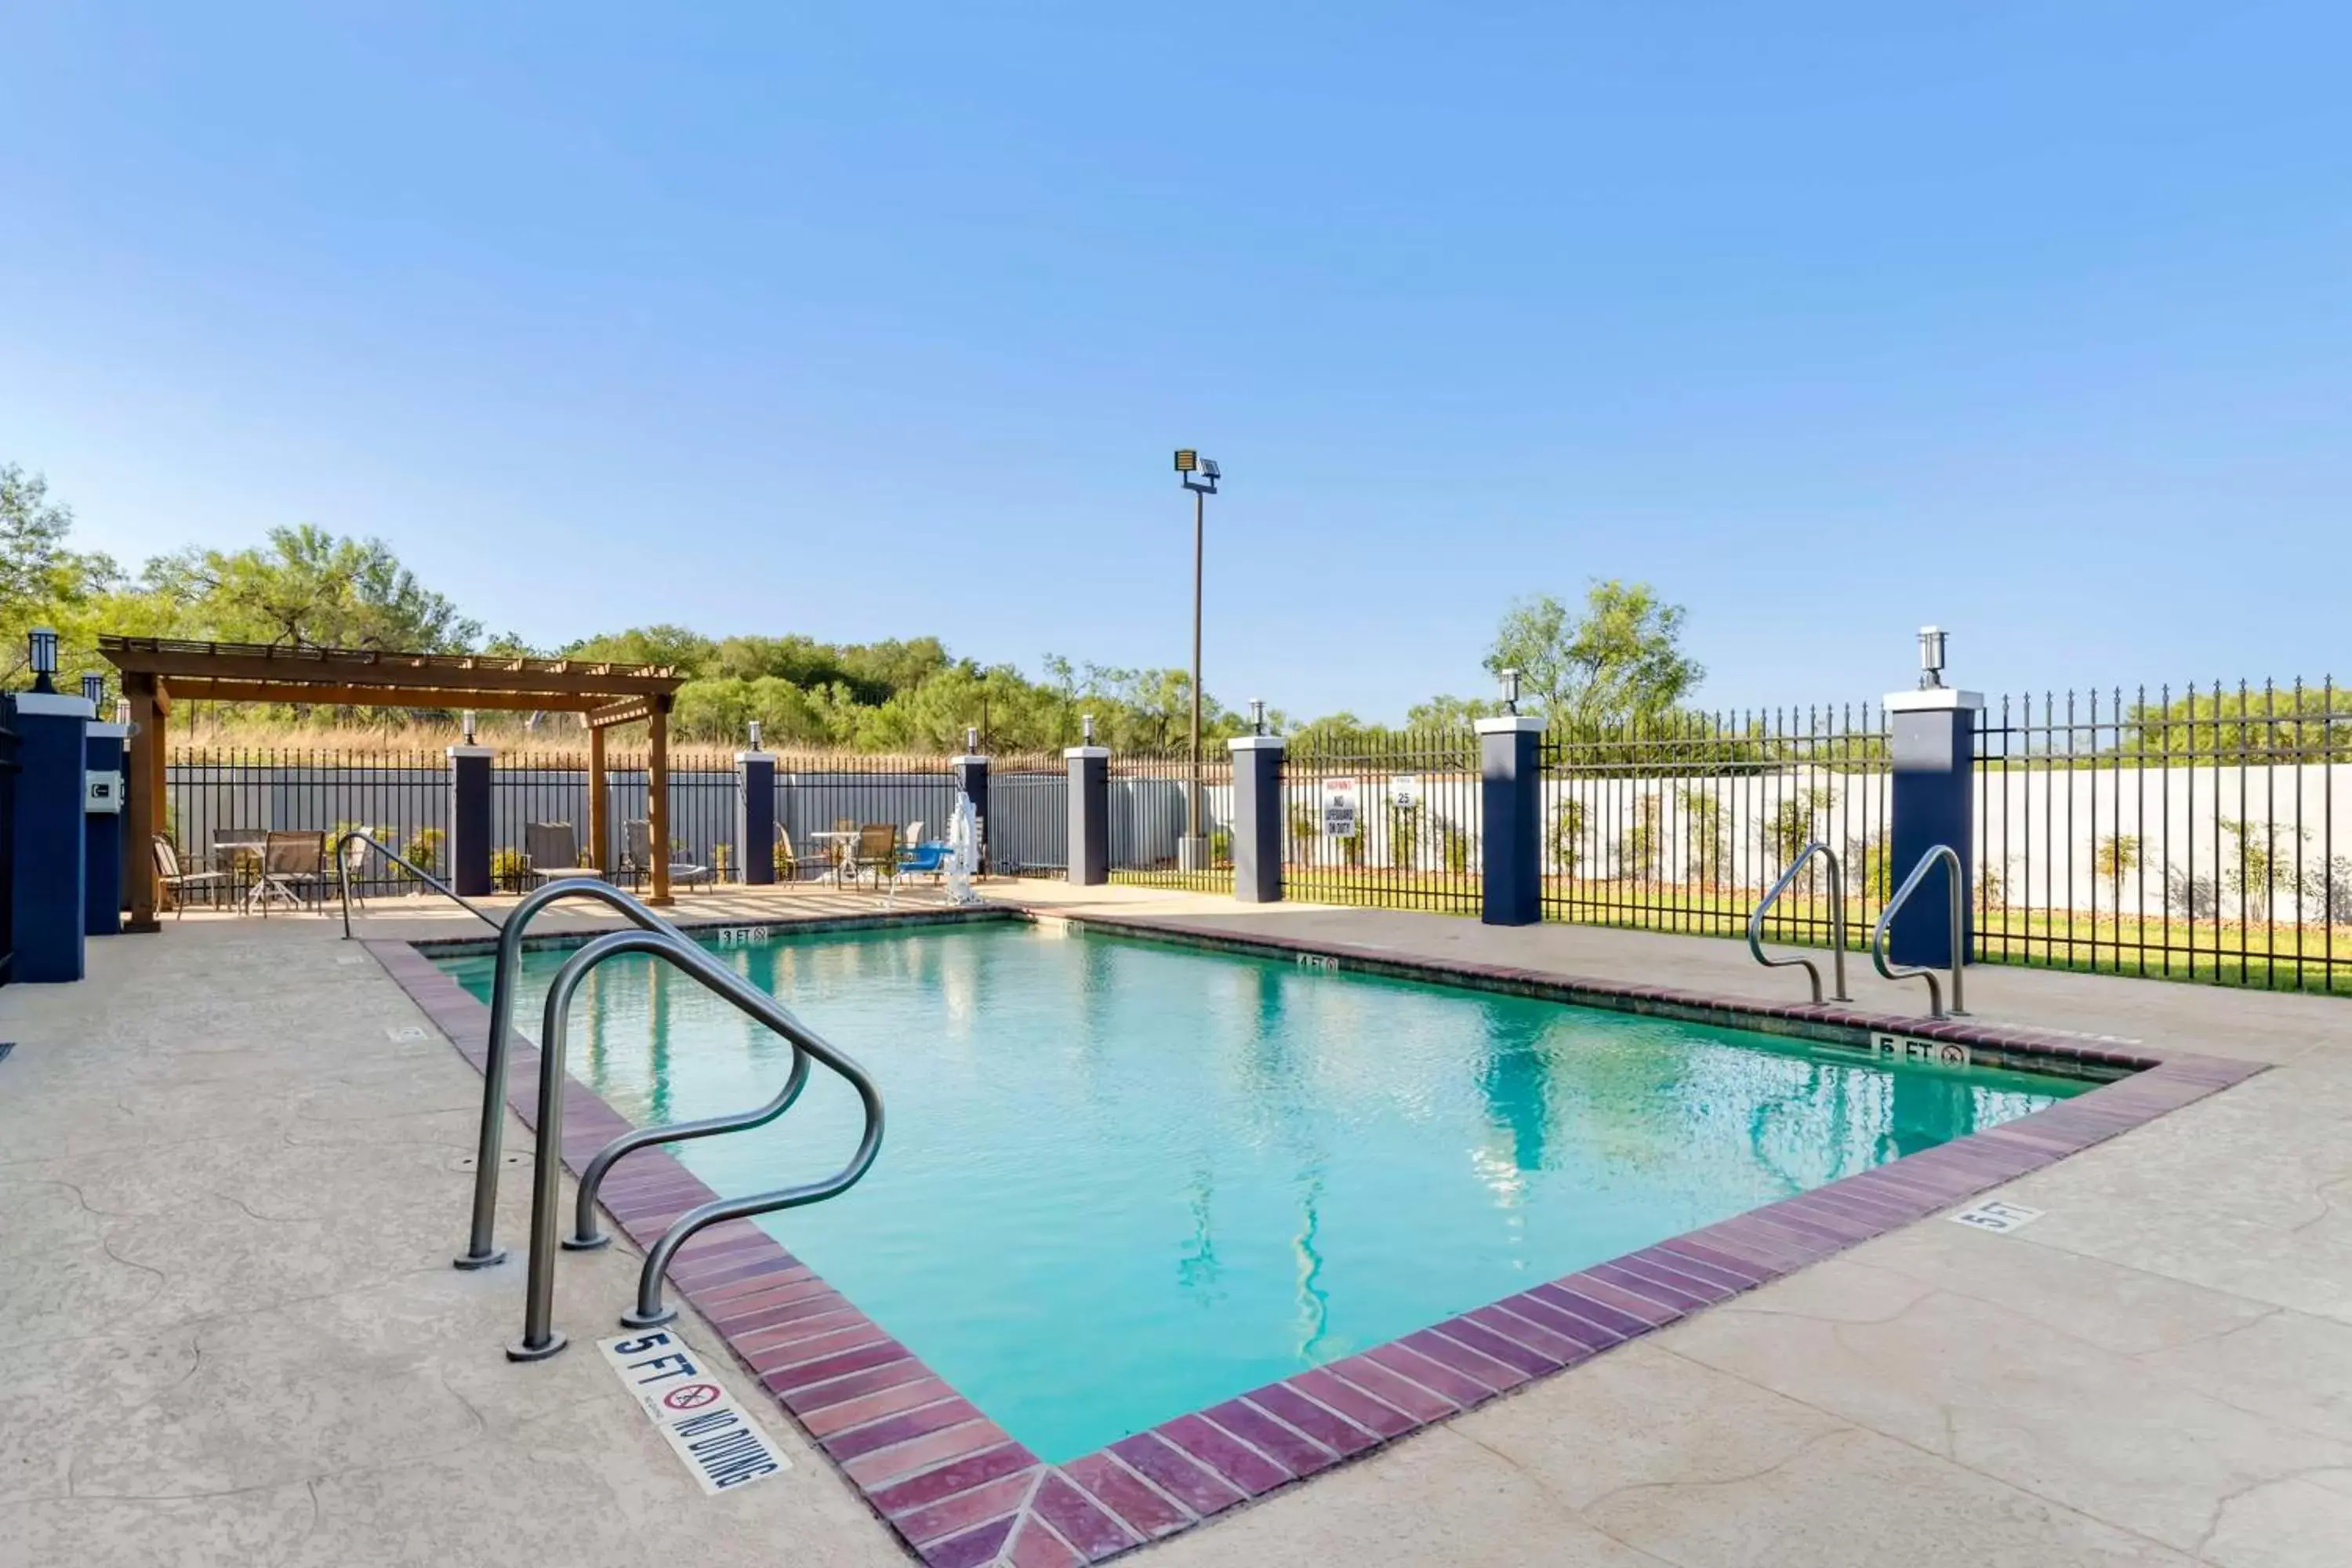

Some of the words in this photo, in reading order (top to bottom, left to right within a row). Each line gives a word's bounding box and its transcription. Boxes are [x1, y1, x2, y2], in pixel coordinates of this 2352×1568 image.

[1398, 793, 1410, 804] 25
[737, 929, 750, 942] FT
[1906, 1040, 1933, 1060] FT
[1961, 1214, 2008, 1229] 5
[1980, 1202, 2034, 1221] FT
[614, 1333, 670, 1354] 5
[627, 1353, 697, 1385] FT
[671, 1408, 739, 1437] NO
[687, 1428, 779, 1488] DIVING
